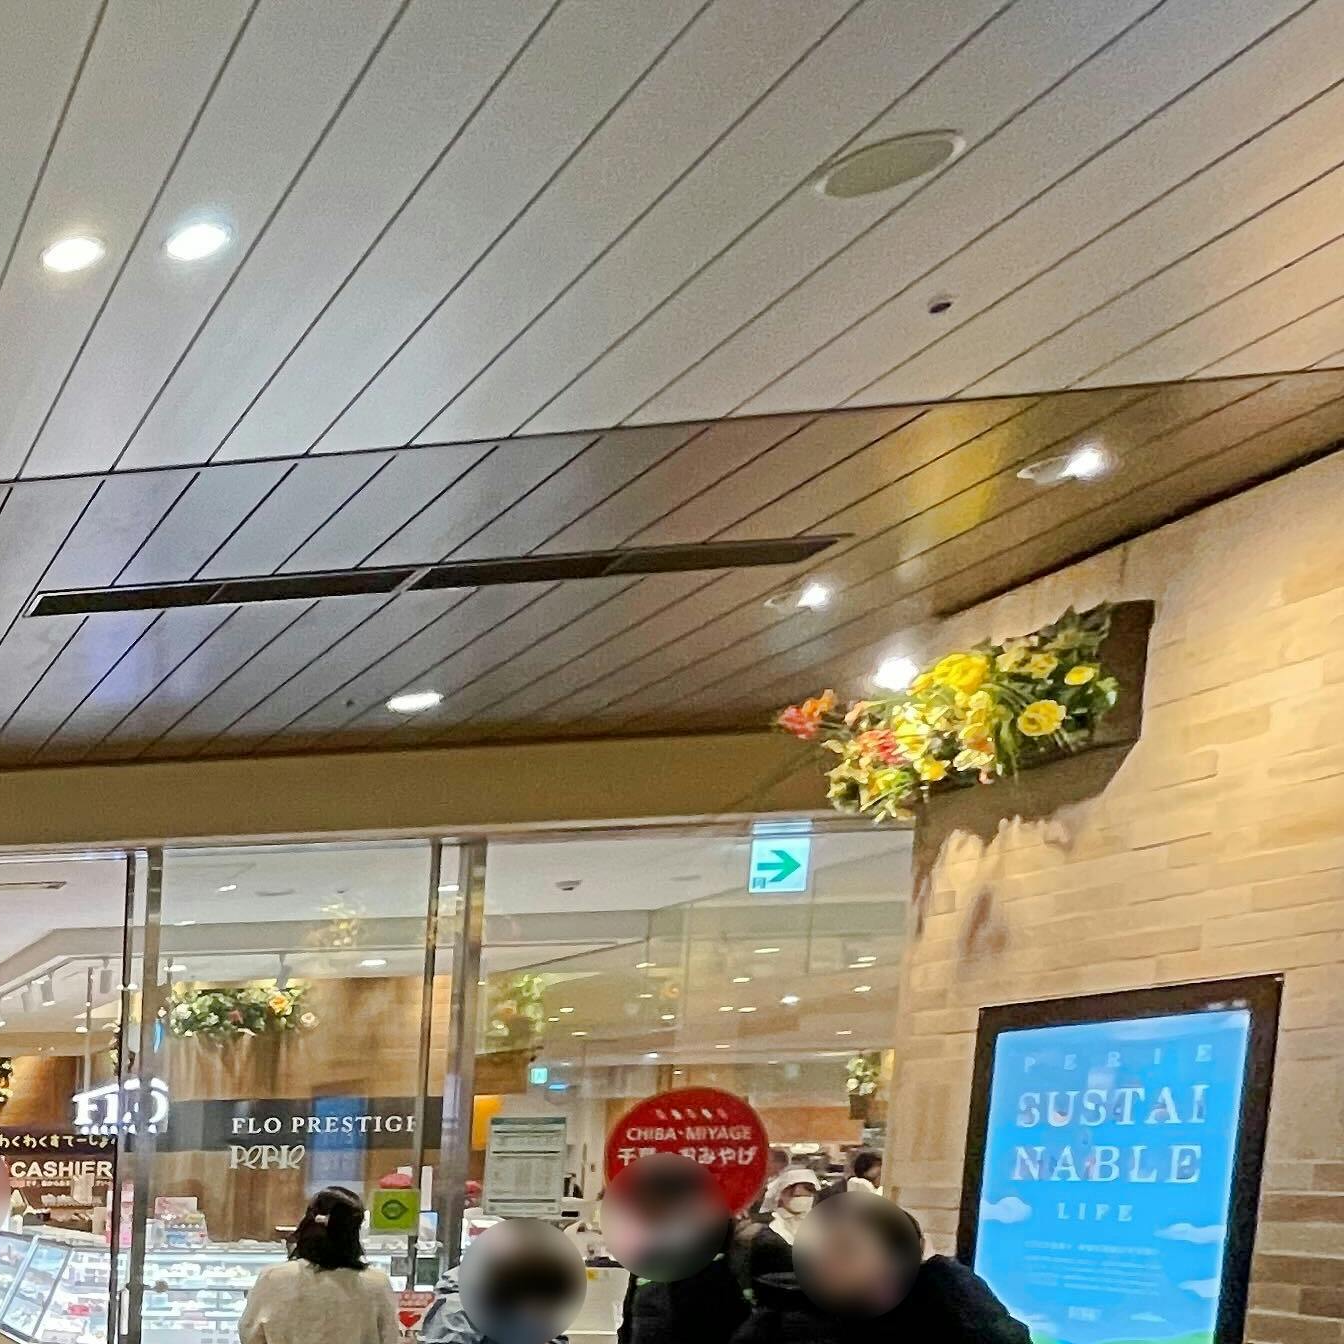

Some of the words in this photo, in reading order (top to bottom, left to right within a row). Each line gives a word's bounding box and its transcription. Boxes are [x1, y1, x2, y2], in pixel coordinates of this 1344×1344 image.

[1015, 1084, 1212, 1129] SUSTAI
[232, 1116, 282, 1135] FLO
[10, 1161, 113, 1179] CASHIER
[1010, 1145, 1202, 1185] NABLE
[1057, 1202, 1133, 1222] LIFE
